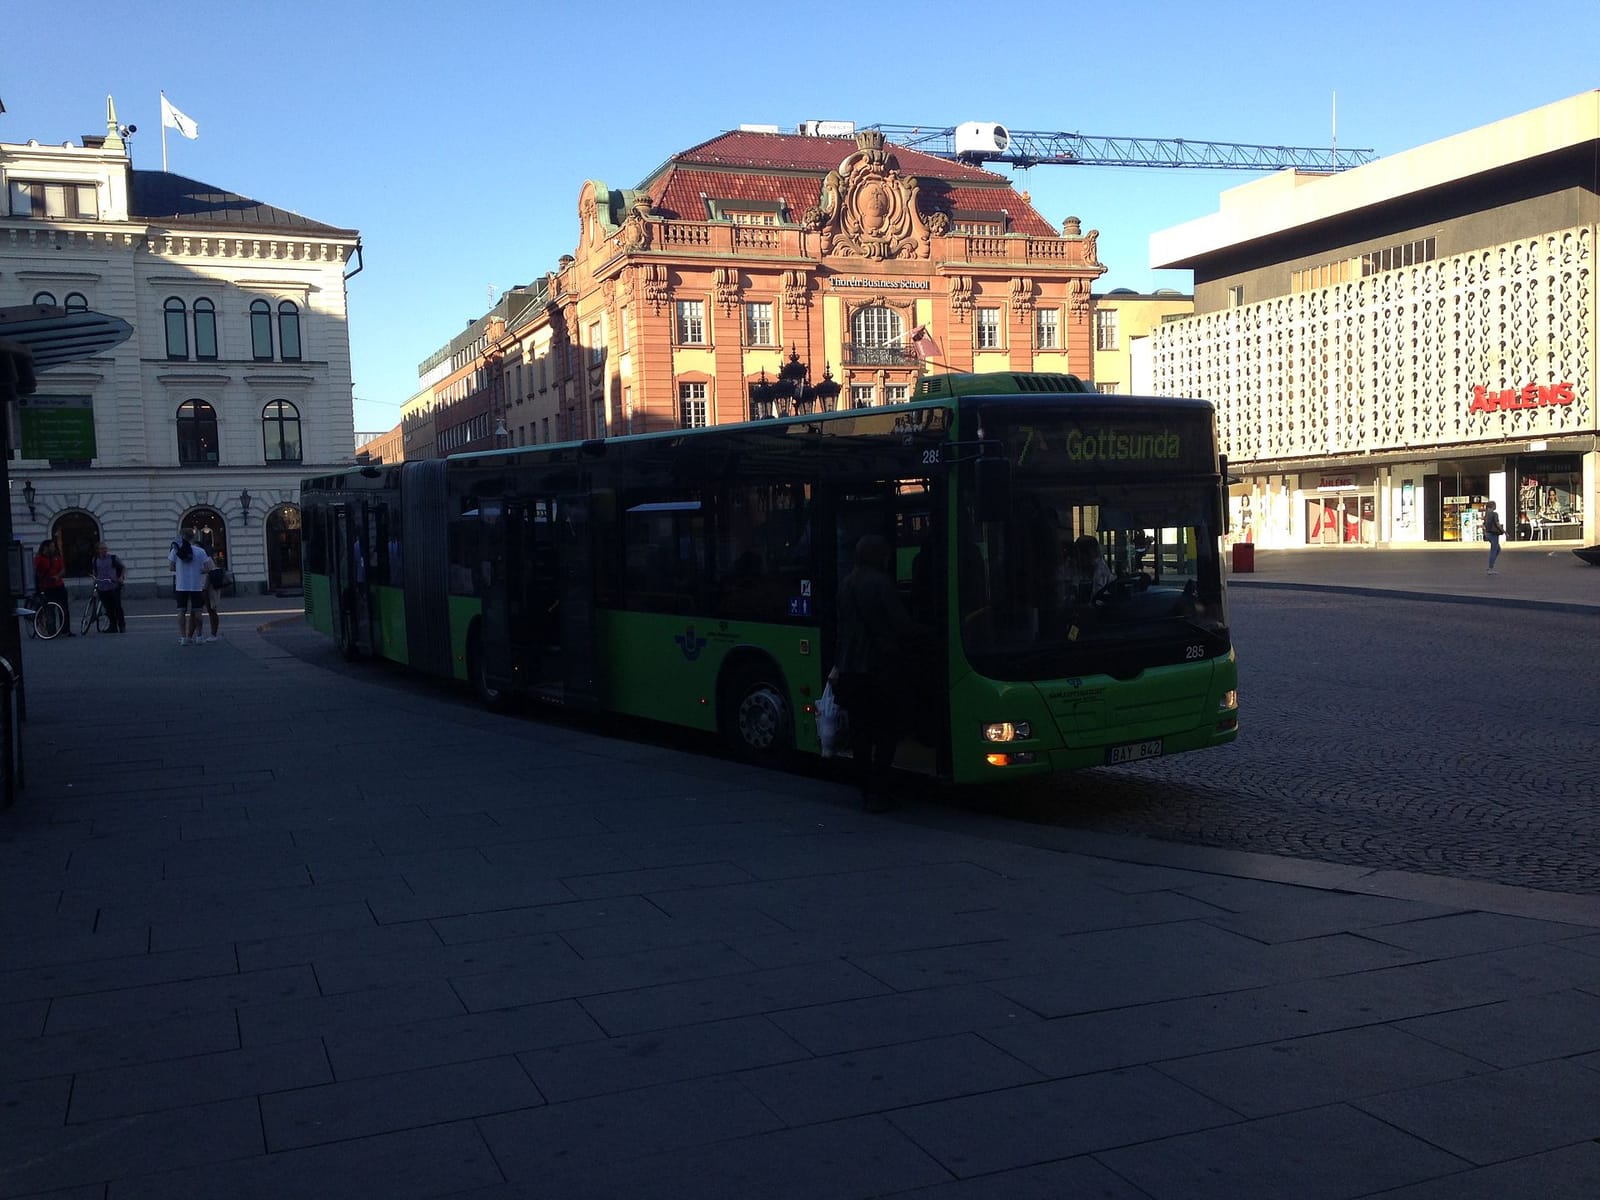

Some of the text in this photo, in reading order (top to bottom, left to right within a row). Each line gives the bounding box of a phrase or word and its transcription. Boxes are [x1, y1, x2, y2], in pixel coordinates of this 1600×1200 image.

[862, 278, 898, 288] Business
[900, 279, 928, 289] School
[1469, 382, 1576, 415] ÅHLÉNS
[1018, 426, 1182, 465] 7 Gottsunda
[1185, 644, 1205, 659] 285
[1113, 742, 1160, 762] BAY 842
